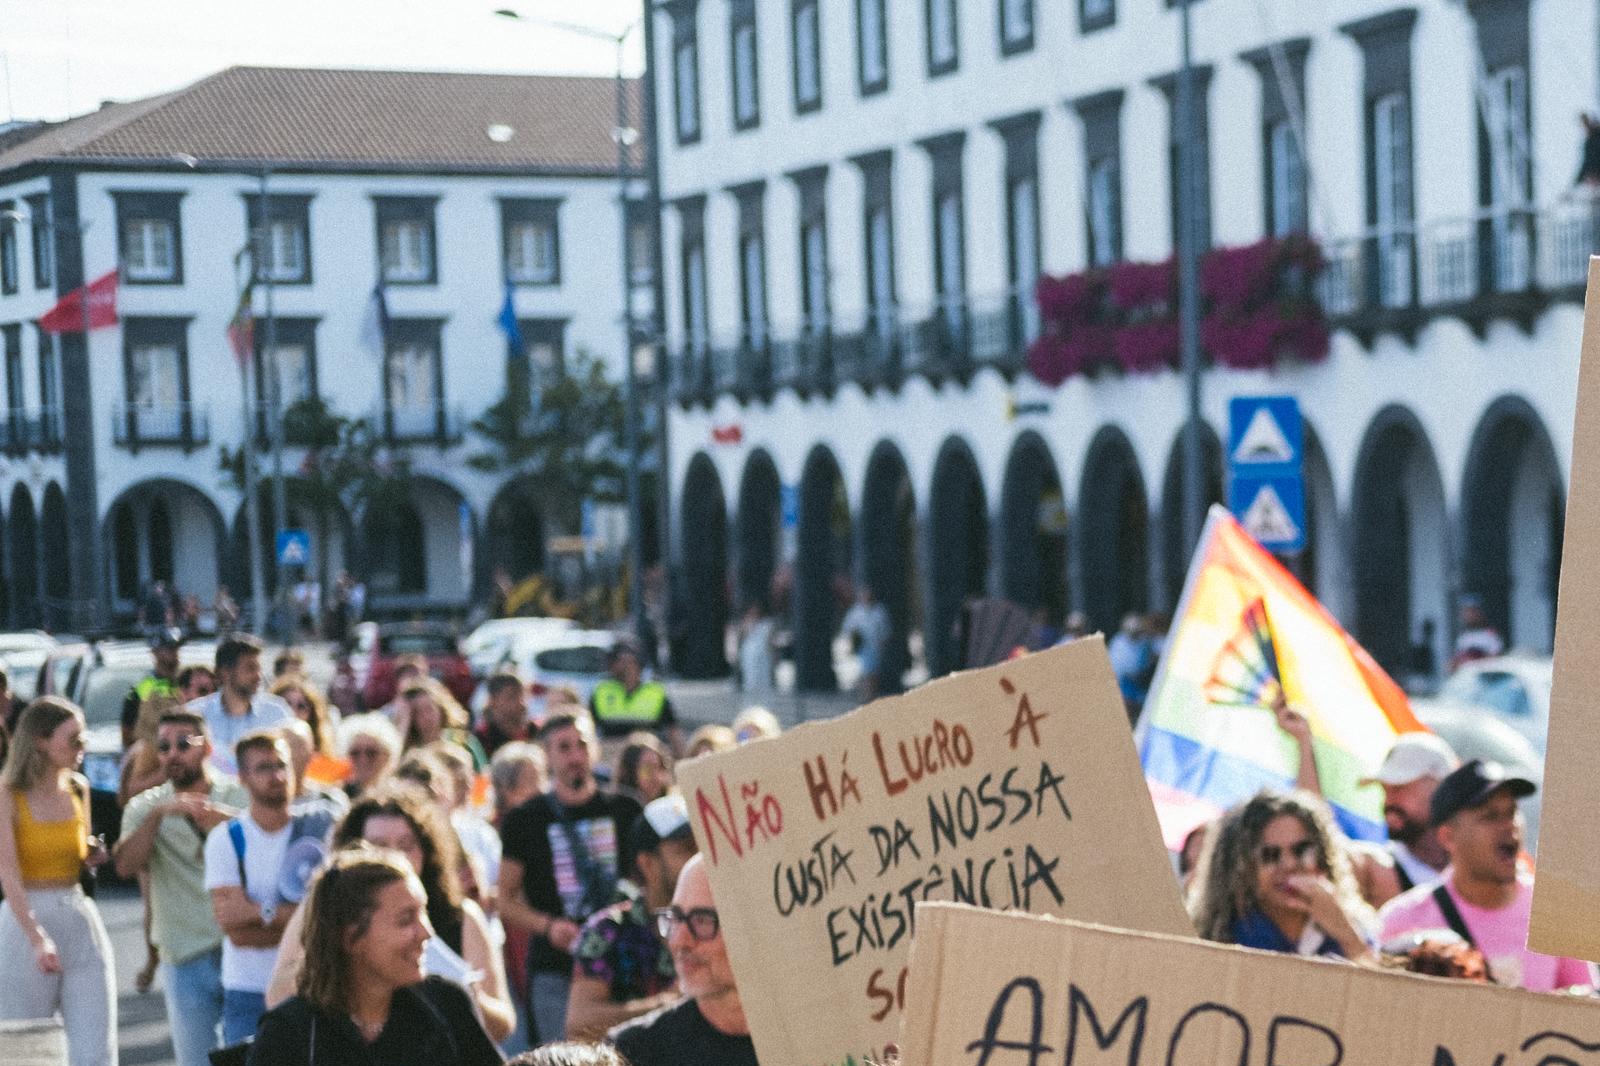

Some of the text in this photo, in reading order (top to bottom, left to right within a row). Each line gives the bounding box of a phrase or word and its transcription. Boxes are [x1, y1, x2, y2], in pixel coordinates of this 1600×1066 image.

[697, 677, 1048, 865] NÃO HÁ LUCRO À
[774, 762, 1073, 917] CUSTA DA NOSSA
